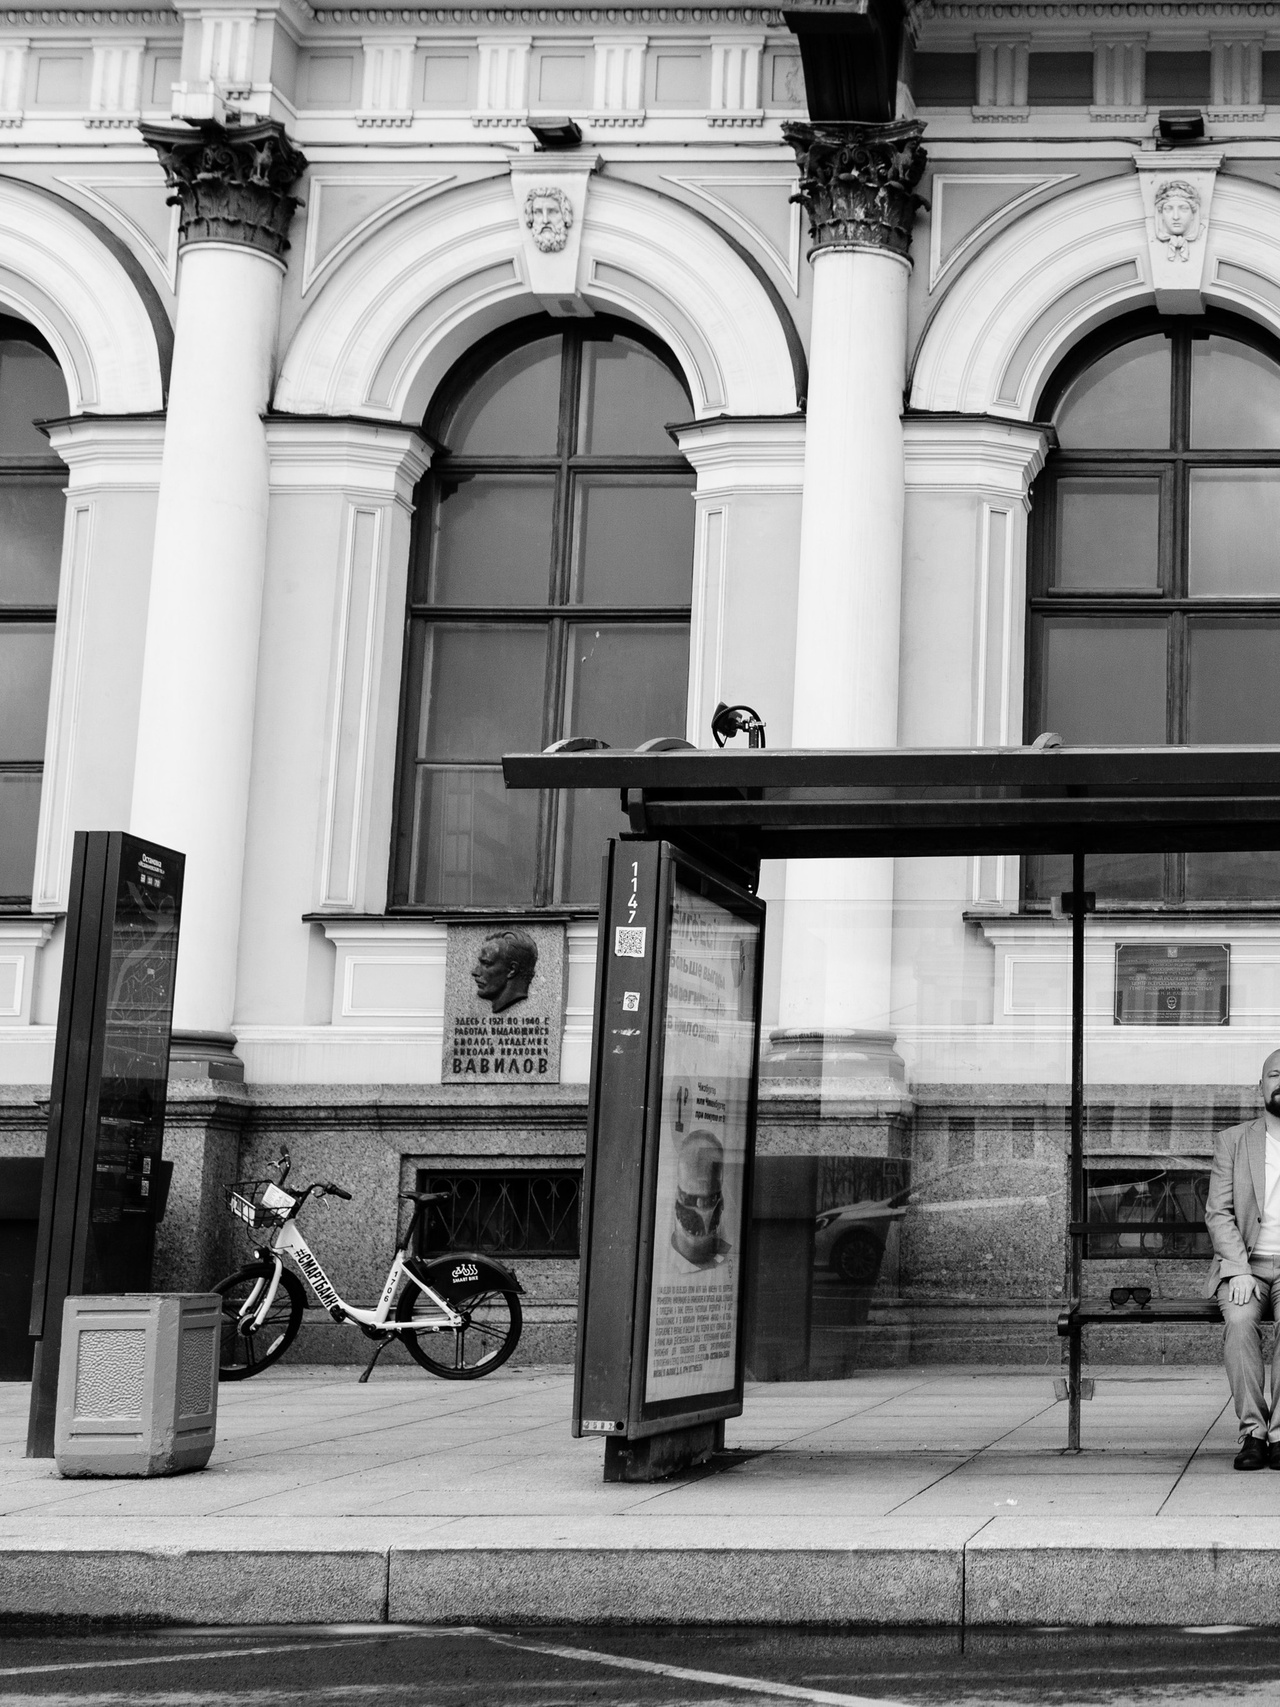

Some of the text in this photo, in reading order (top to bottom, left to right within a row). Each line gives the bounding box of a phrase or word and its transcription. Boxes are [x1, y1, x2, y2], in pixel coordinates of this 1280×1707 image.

[627, 861, 639, 924] 1147
[455, 1017, 480, 1026] ЗДЕСЬ
[481, 1017, 487, 1025] С
[489, 1017, 504, 1025] 1921
[507, 1017, 518, 1025] ПО
[522, 1017, 540, 1025] 1940
[454, 1026, 549, 1036] РАБОТАЛ ВЫДАЮЩИЙСЯ
[498, 1037, 549, 1046] АКАДЕМИК
[453, 1046, 549, 1056] НИКОЛАЙ ИВАНОВИЧ
[452, 1058, 548, 1074] ВАВИЛОВ
[452, 1276, 468, 1284] SMART
[383, 1270, 399, 1303] 1706
